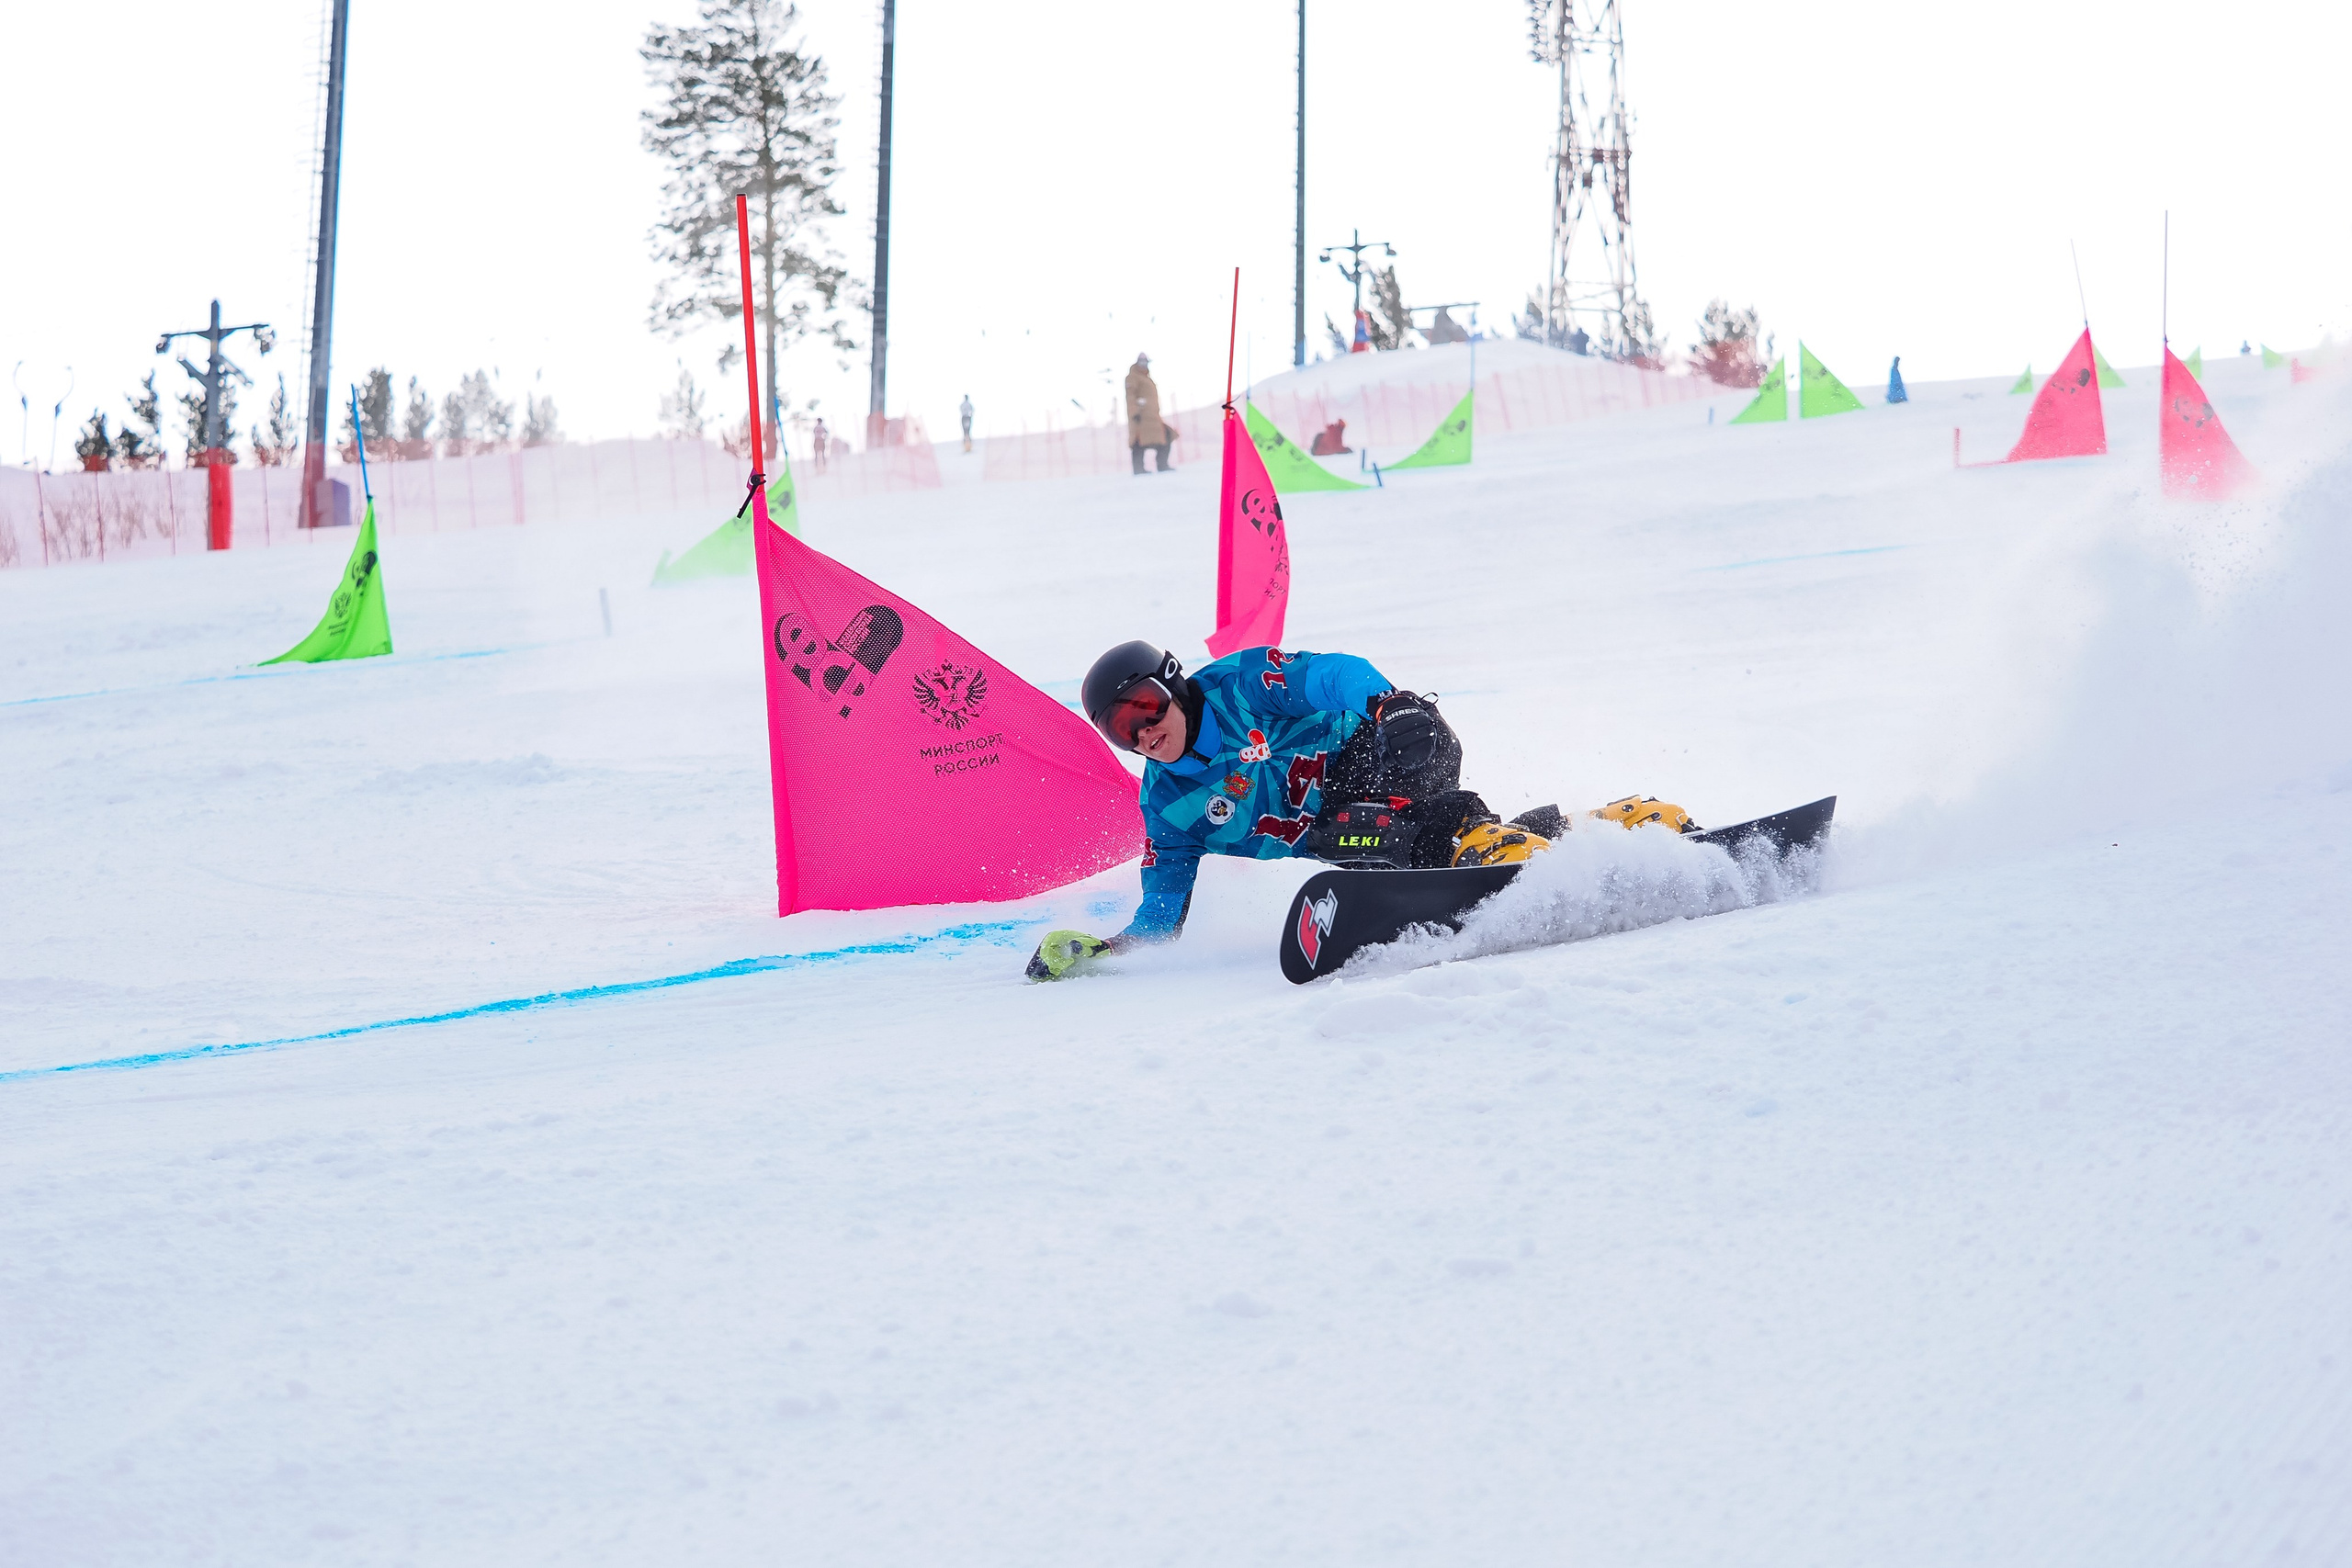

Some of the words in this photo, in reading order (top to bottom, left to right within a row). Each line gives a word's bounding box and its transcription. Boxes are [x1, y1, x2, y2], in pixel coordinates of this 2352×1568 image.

[1385, 708, 1419, 722] SHRED
[920, 733, 1003, 760] МИНСПОРТ
[933, 753, 1001, 776] РОССИИ
[1339, 835, 1380, 847] LEKI
